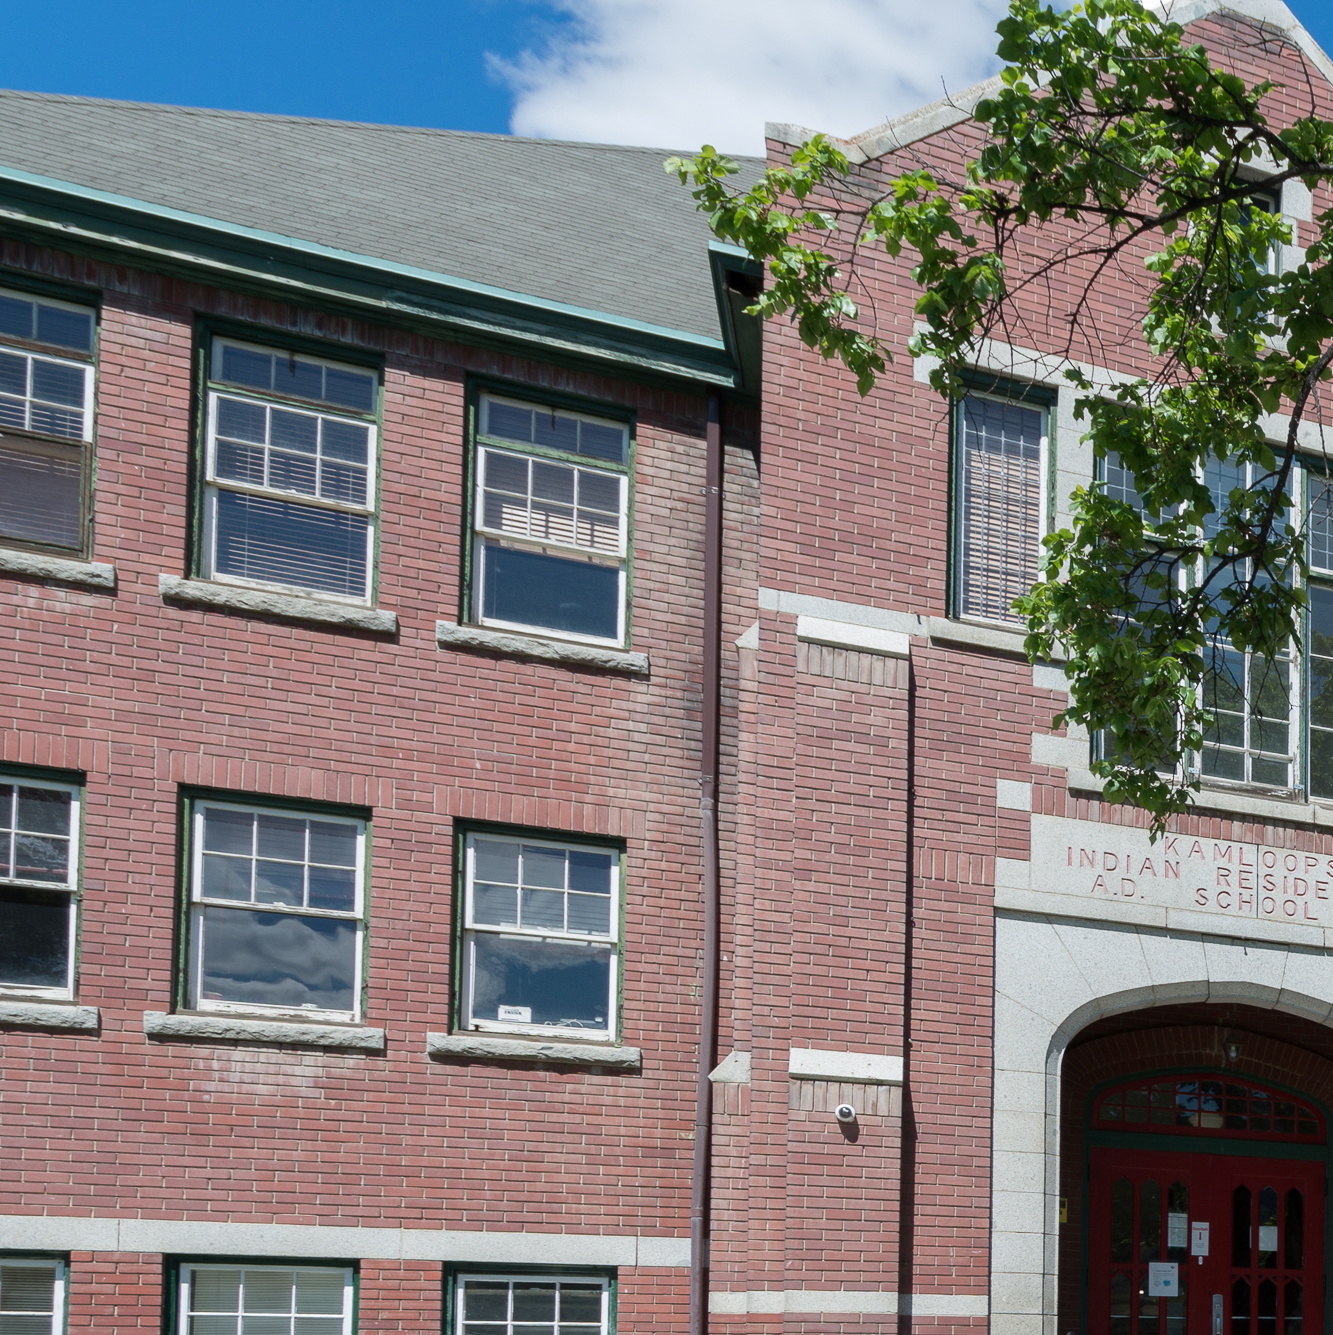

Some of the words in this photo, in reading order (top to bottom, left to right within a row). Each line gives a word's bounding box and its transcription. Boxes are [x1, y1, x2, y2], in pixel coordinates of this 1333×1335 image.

[1066, 846, 1182, 880] INDIAN
[1090, 875, 1145, 900] A.D.
[1194, 888, 1320, 922] SCHOOL
